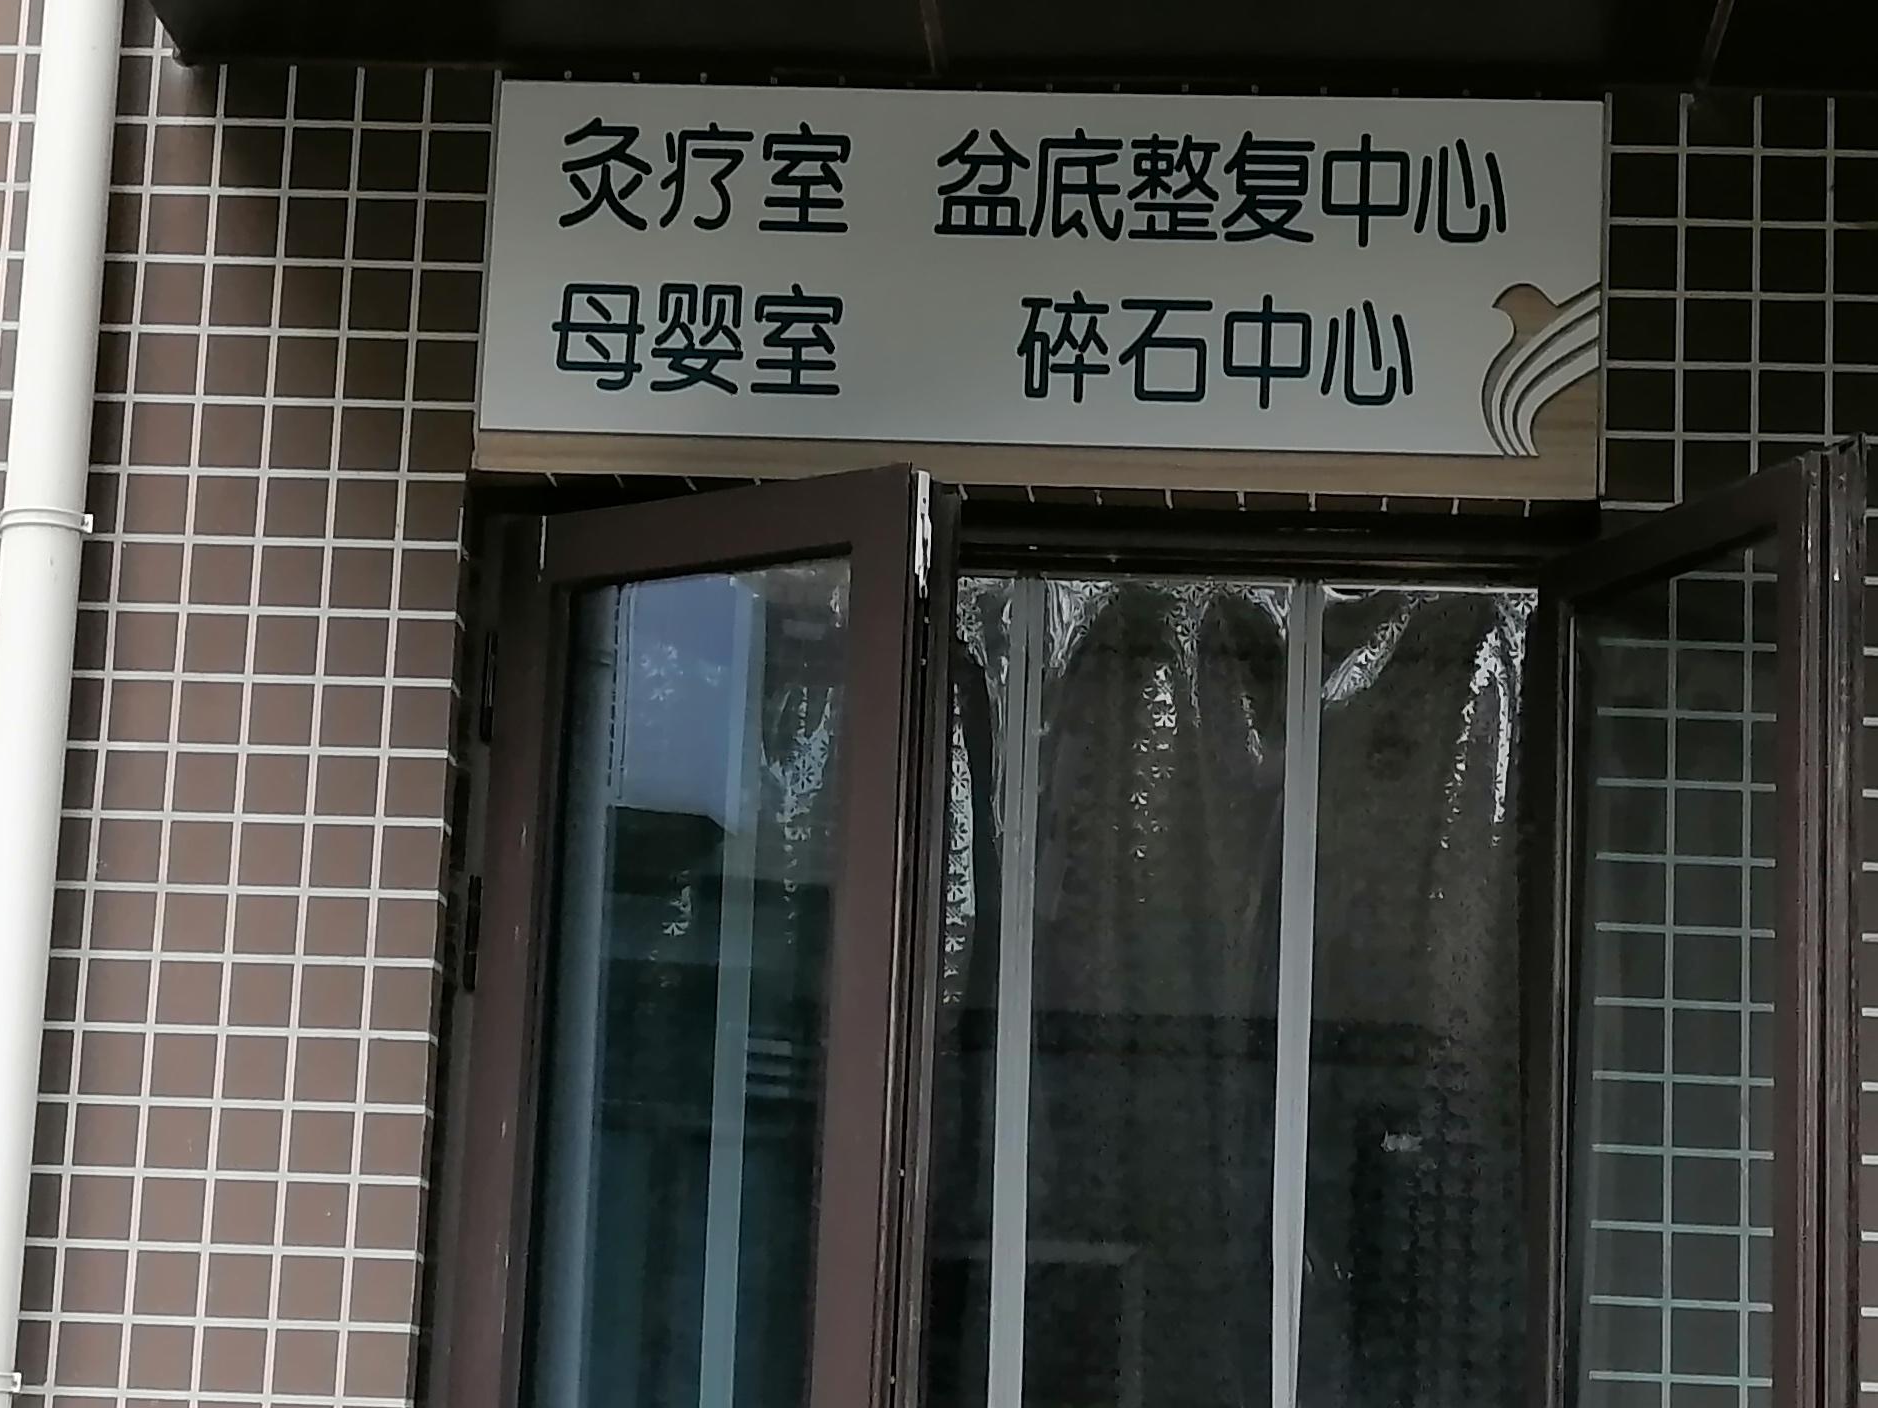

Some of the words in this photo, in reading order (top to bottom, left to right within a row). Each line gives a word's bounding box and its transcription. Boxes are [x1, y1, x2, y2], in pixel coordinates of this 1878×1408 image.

[558, 116, 852, 234] 灸疗室
[933, 127, 1508, 248] 盆底整复中心
[551, 282, 844, 396] 母婴室
[1016, 289, 1415, 410] 碎石中心
